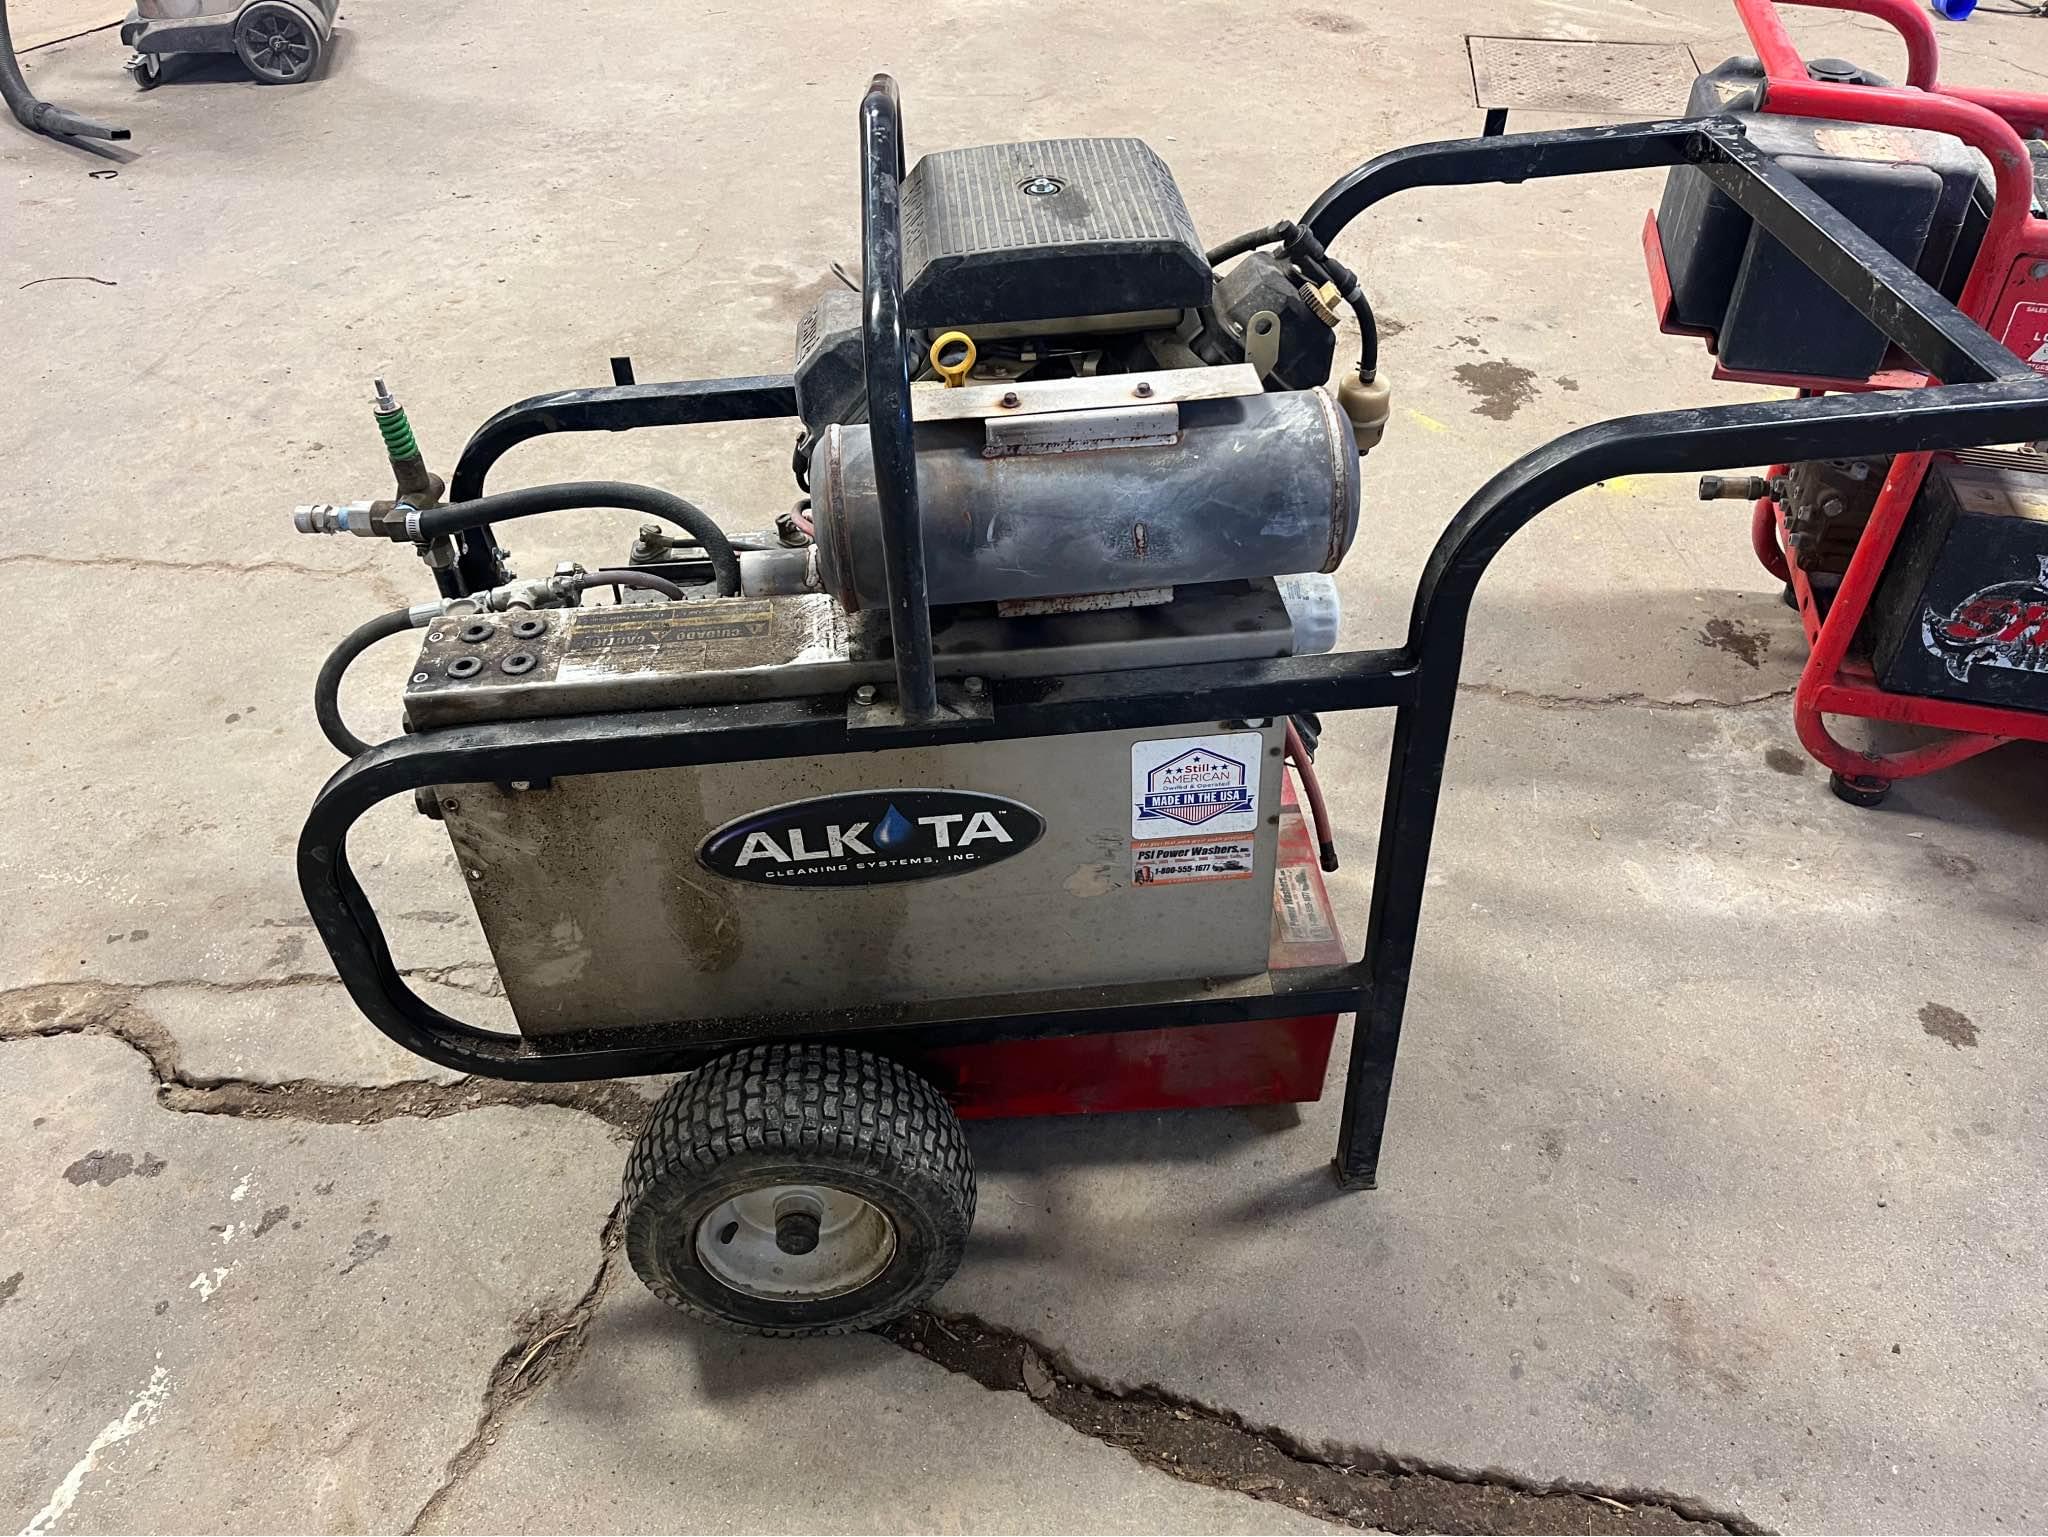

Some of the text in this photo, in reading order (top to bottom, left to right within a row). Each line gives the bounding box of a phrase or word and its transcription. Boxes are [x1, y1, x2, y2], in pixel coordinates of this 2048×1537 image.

[676, 628, 740, 641] CUIDADO
[1185, 764, 1209, 773] Still
[1163, 772, 1230, 784] AMERICAN
[1152, 790, 1240, 807] MADE IN THE USA
[1138, 850, 1155, 860] PSI
[1156, 849, 1189, 859] Power
[765, 853, 981, 878] CLEANING SYSTEMS, INC.
